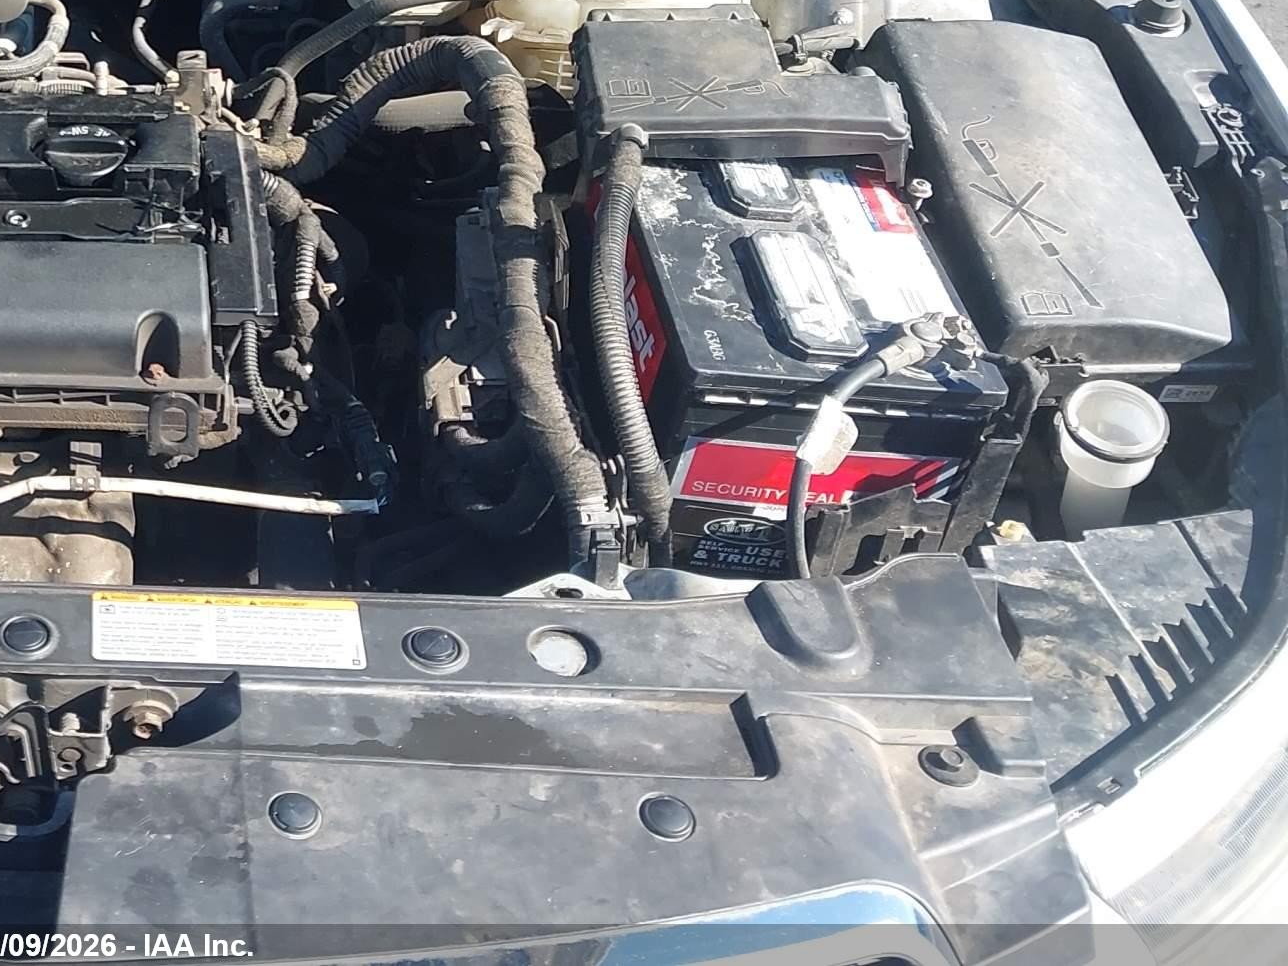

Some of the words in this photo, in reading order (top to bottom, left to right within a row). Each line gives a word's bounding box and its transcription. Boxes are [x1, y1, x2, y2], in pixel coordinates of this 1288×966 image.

[623, 272, 654, 373] last
[691, 480, 789, 501] SECURITY
[805, 491, 838, 505] EAL
[693, 549, 708, 560] &
[717, 552, 784, 568] TRUCK
[745, 546, 789, 560] USE
